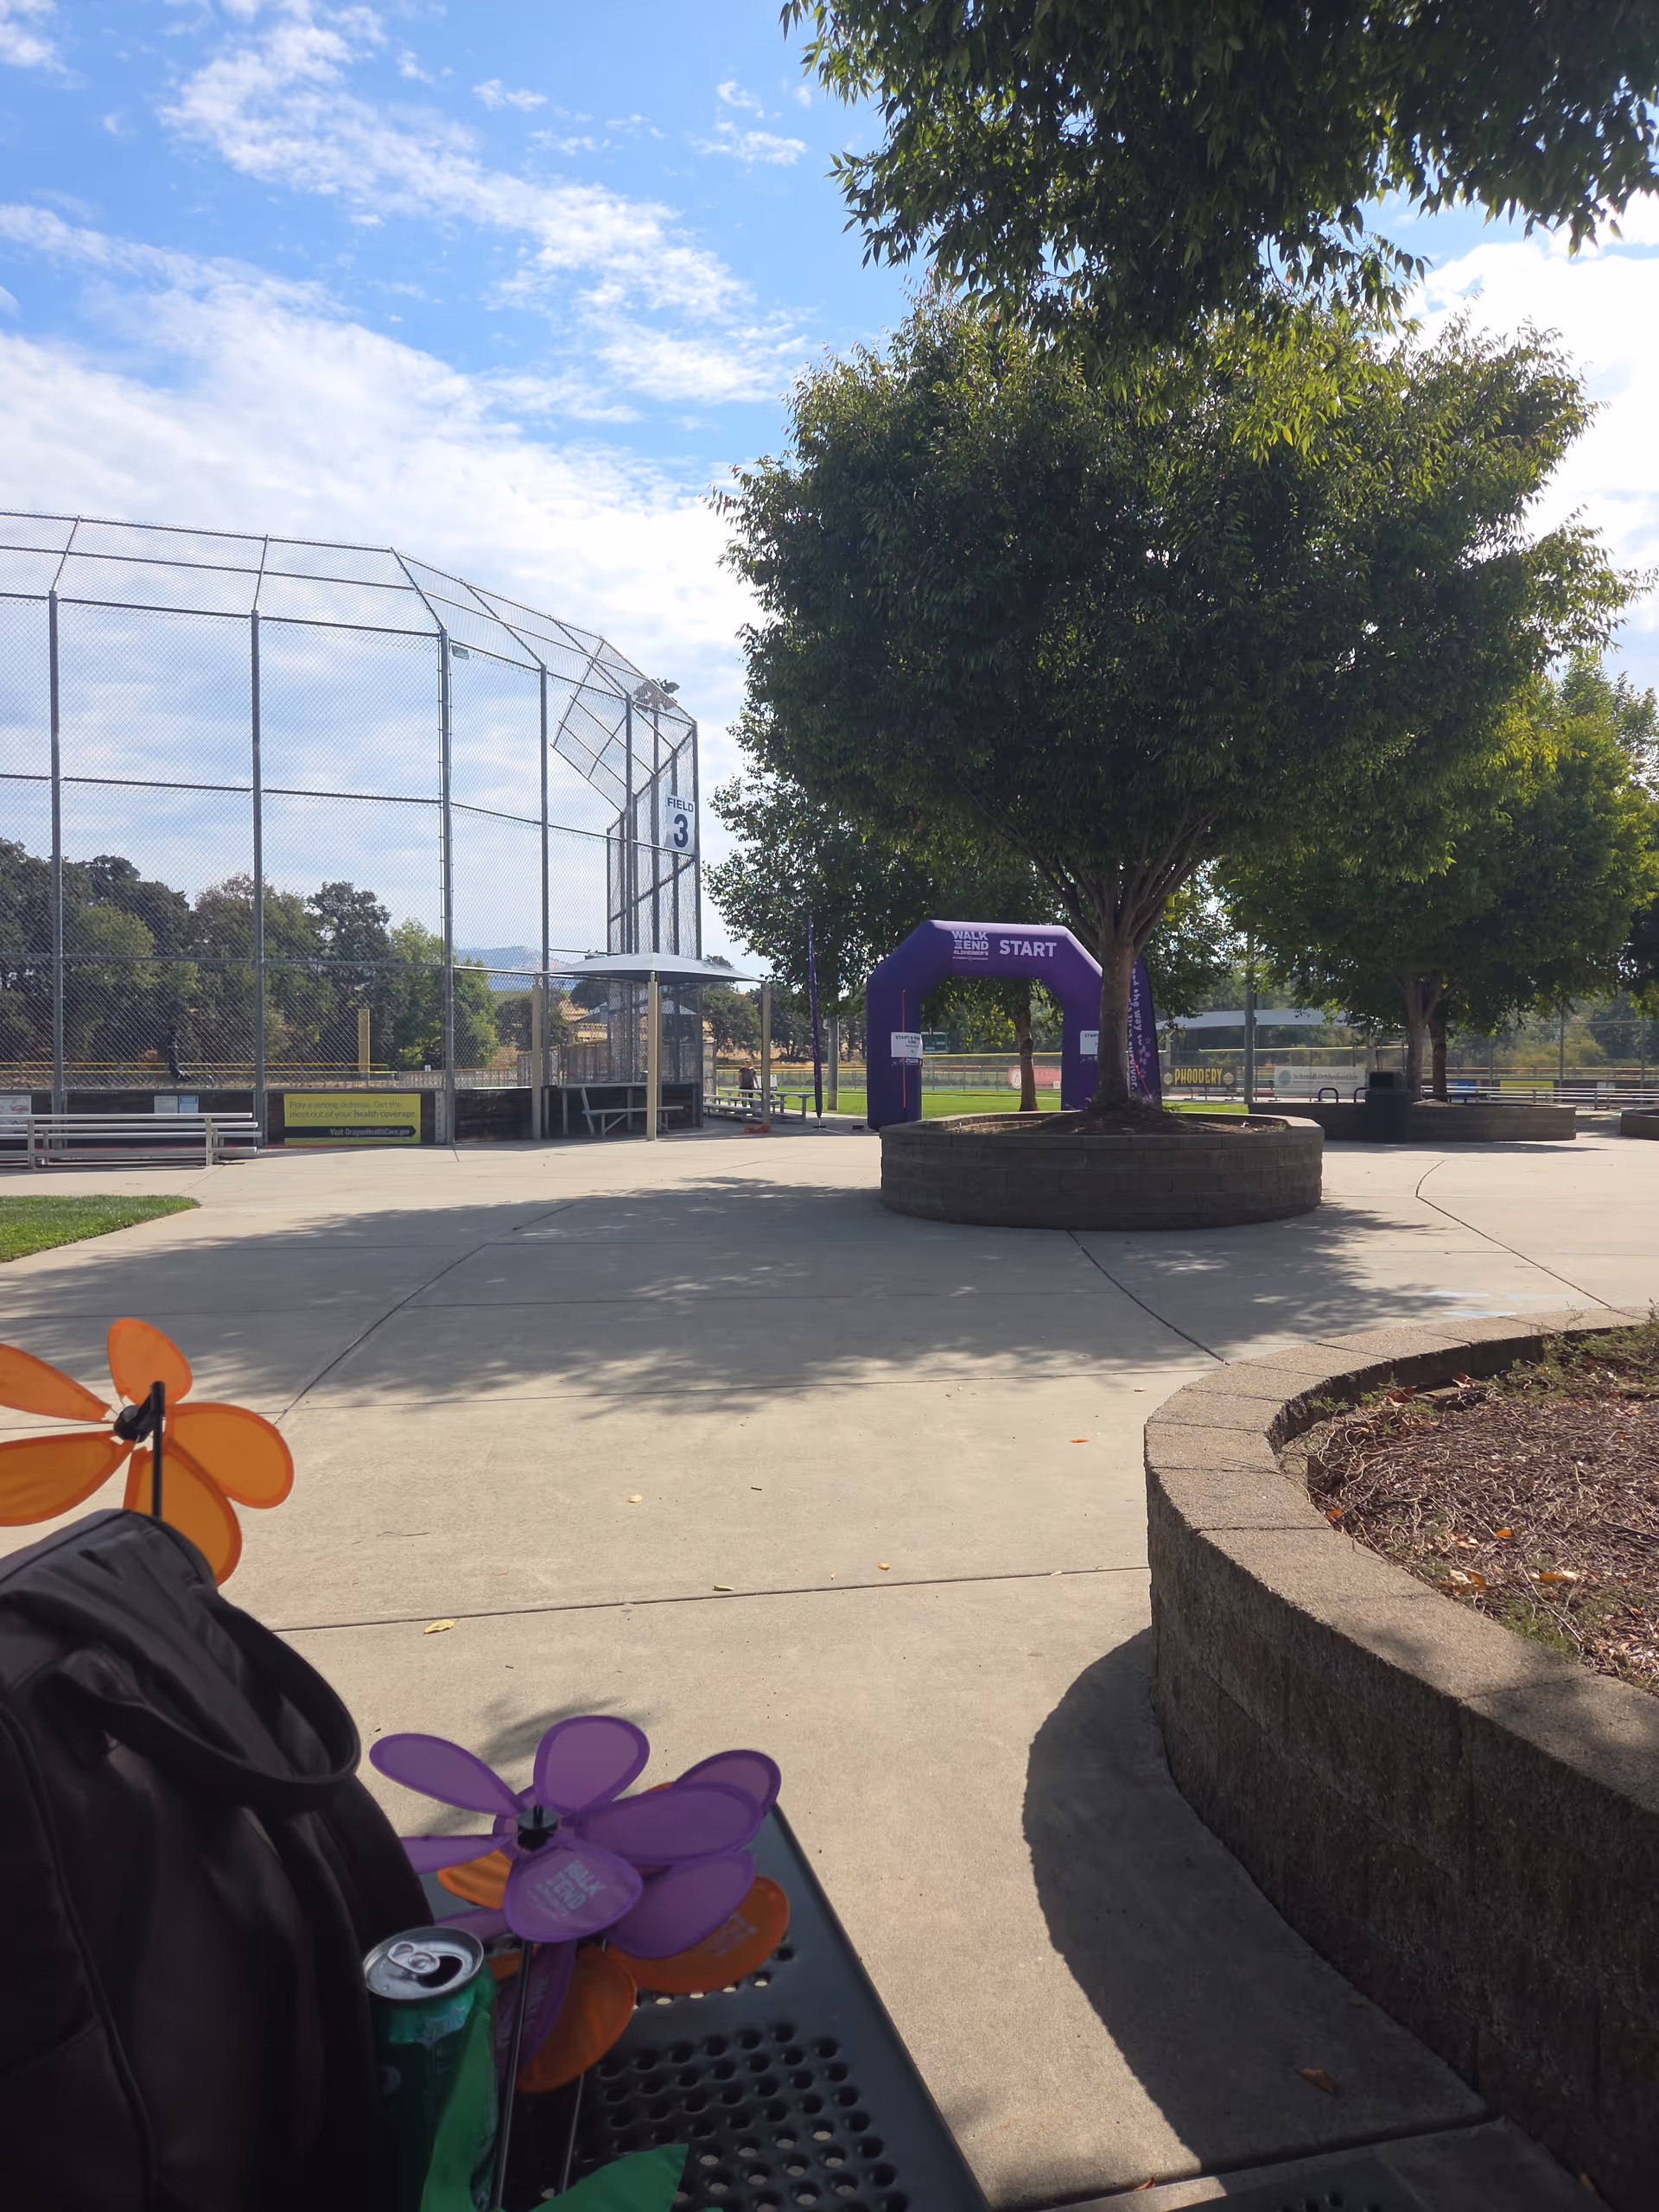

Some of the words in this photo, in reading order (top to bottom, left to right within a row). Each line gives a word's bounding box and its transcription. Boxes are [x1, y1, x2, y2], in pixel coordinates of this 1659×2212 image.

[667, 797, 694, 812] FIELD
[674, 814, 689, 848] 3
[951, 931, 988, 941] WALK
[963, 940, 989, 950] END
[999, 939, 1058, 957] START
[1134, 1009, 1143, 1031] way
[1175, 1068, 1223, 1086] PHOODERY
[289, 1101, 306, 1109] Play
[373, 1100, 388, 1109] Get
[388, 1100, 402, 1109] the
[289, 1109, 308, 1118] most
[325, 1109, 334, 1118] of
[335, 1110, 353, 1119] your
[353, 1109, 378, 1118] health
[379, 1110, 416, 1119] coverage
[329, 1128, 344, 1136] Visit
